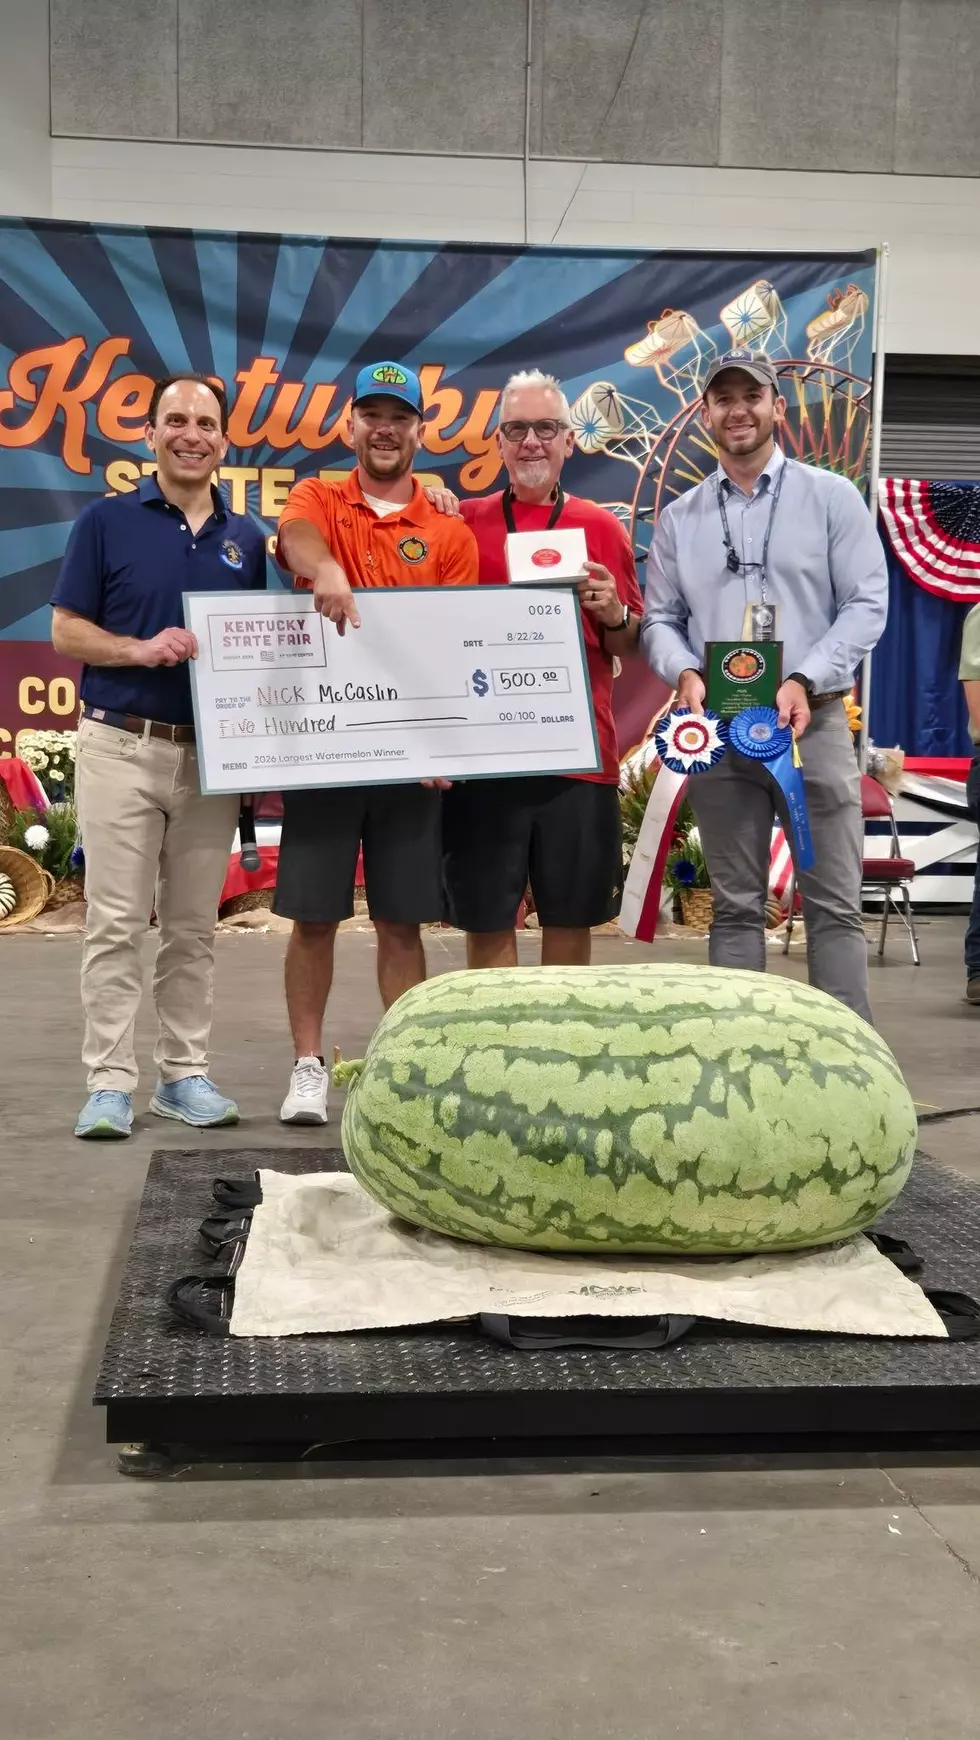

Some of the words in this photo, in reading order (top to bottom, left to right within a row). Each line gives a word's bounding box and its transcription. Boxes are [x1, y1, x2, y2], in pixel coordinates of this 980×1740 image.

[0, 336, 503, 491] Ketuky
[105, 460, 295, 516] STE
[528, 605, 561, 616] 0026
[224, 619, 305, 633] KENTUCKY
[222, 635, 272, 648] STATE
[277, 633, 312, 645] FAIR
[506, 632, 544, 641] 8/22/26
[471, 669, 489, 697] $
[264, 715, 336, 735] Hundred
[499, 711, 536, 721] 00/100
[541, 715, 575, 723] DOLLARS
[222, 762, 248, 770] MEMO
[254, 756, 277, 764] 2026
[278, 754, 313, 763] Largest
[315, 750, 372, 760] Watermelon
[373, 749, 405, 757] Winner
